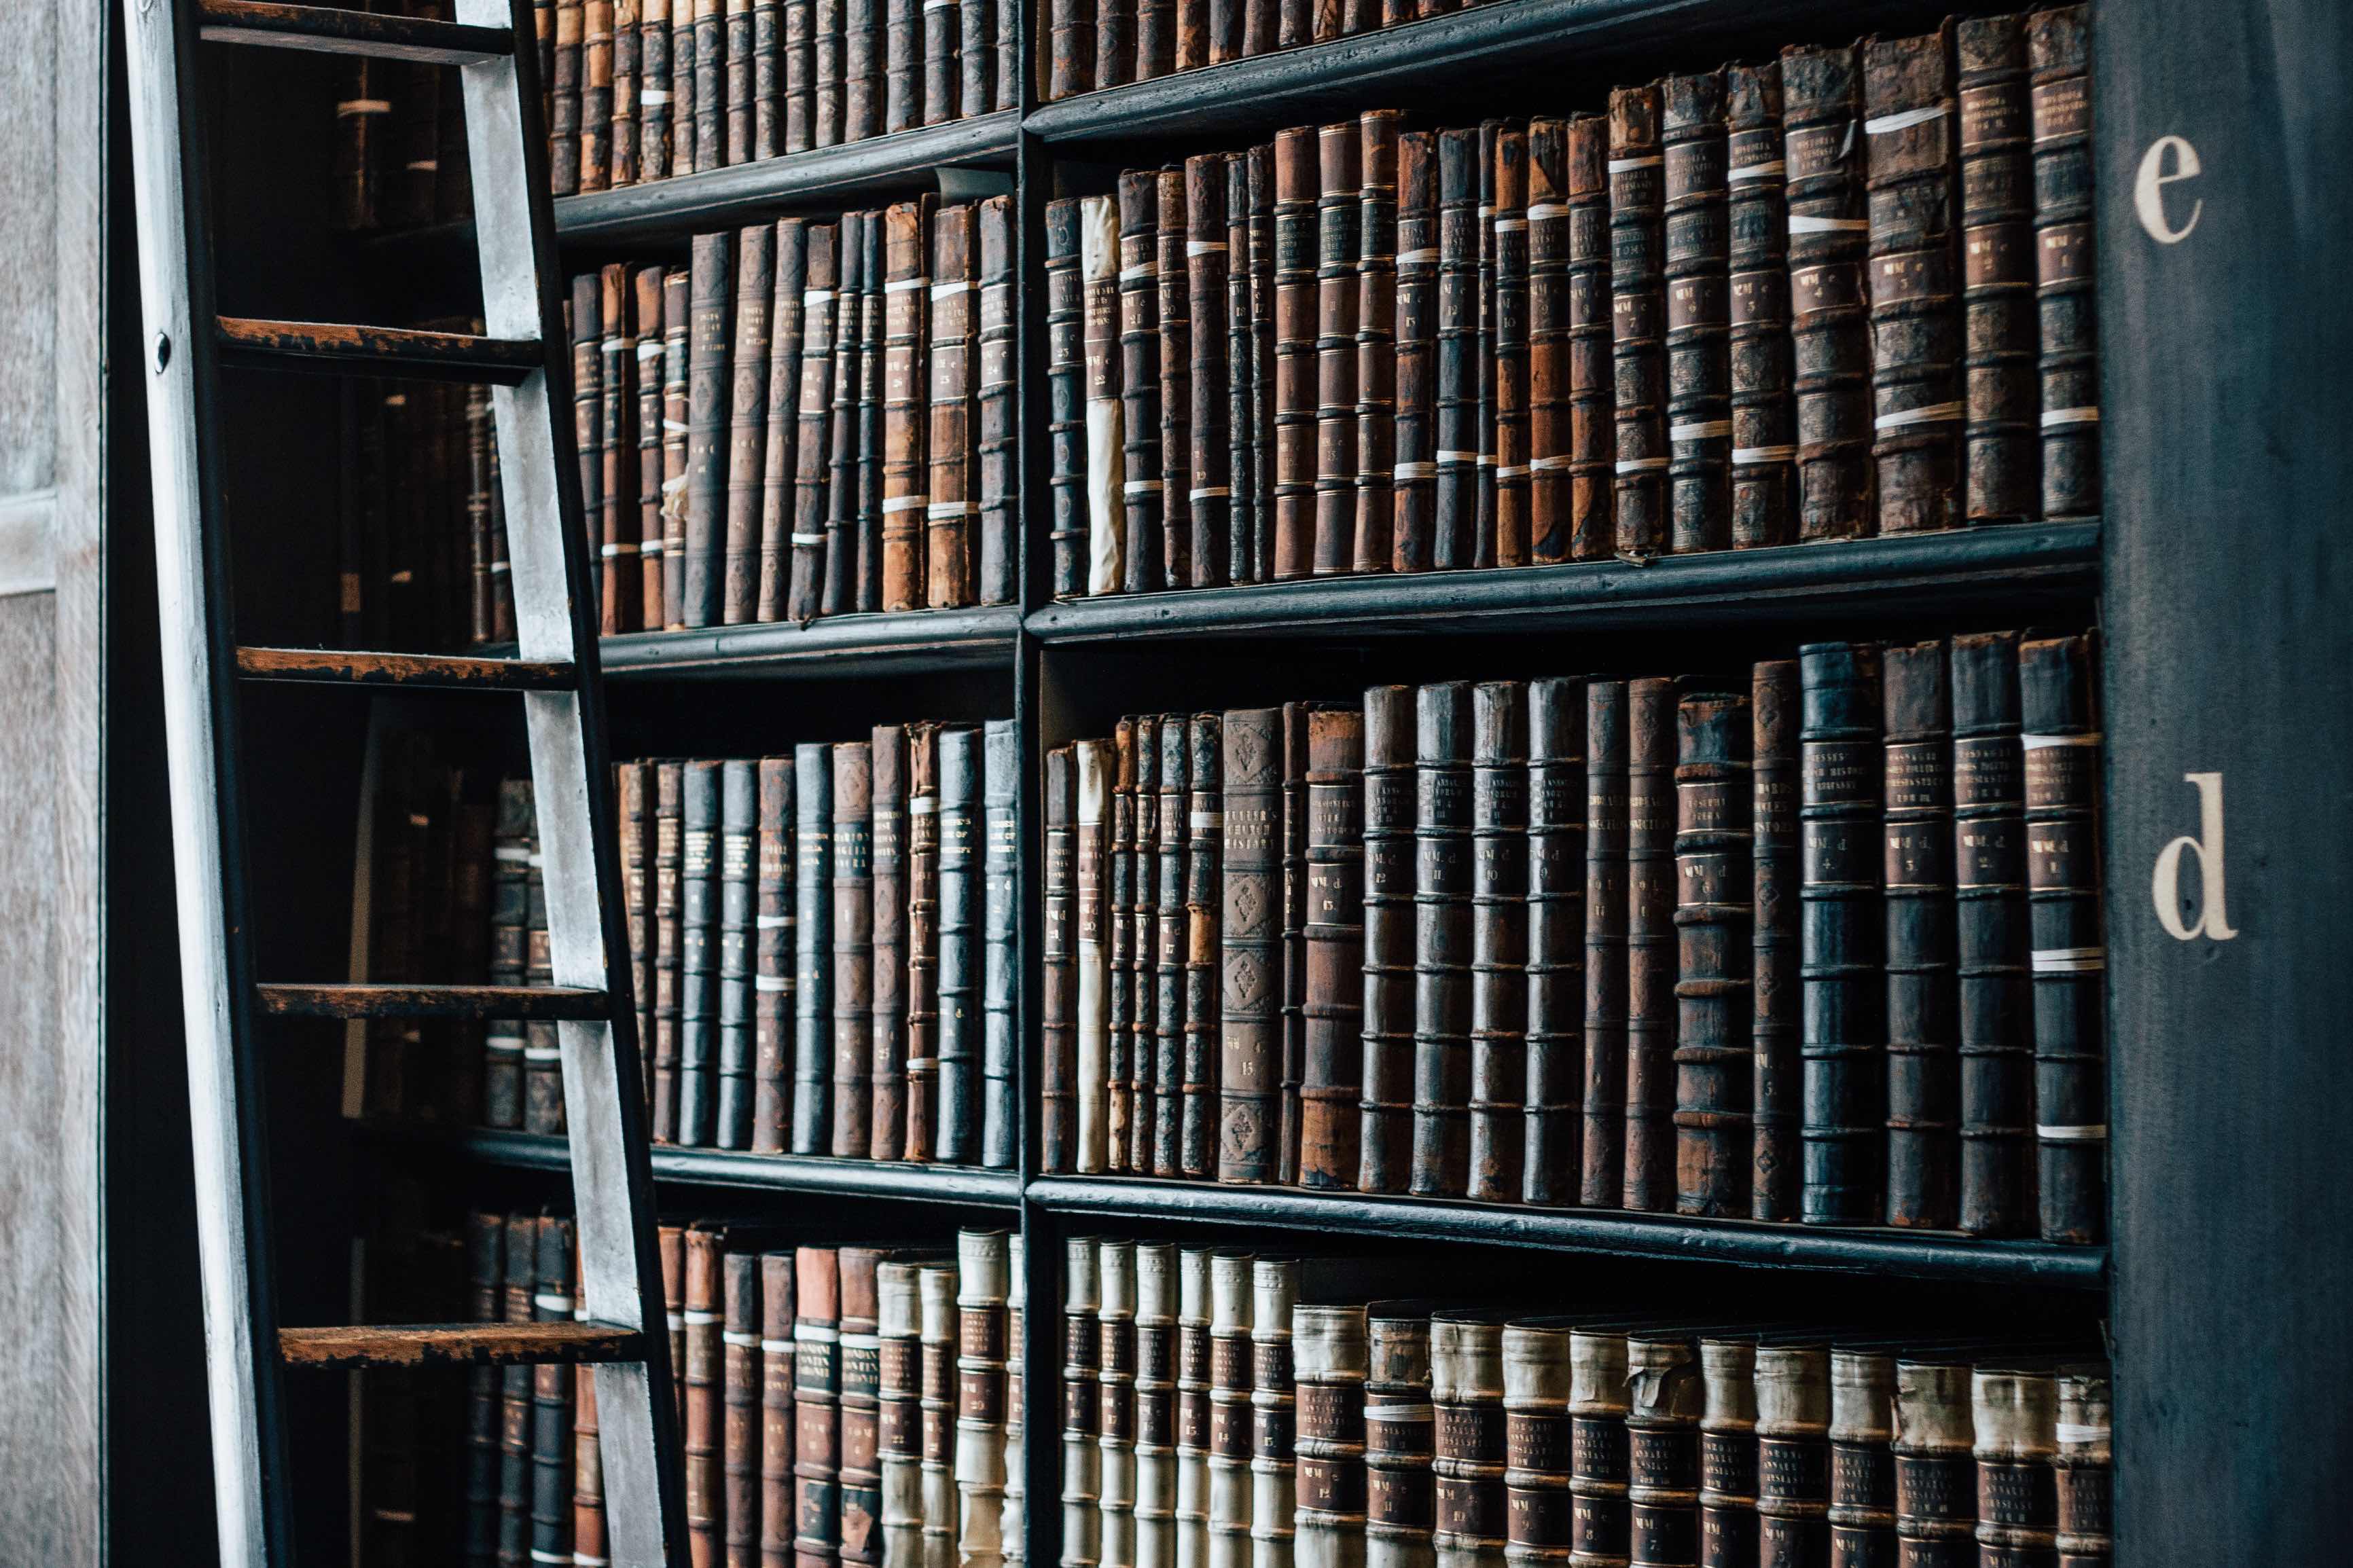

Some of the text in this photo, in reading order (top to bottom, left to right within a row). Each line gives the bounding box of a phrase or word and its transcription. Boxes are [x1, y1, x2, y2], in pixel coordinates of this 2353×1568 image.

[2135, 135, 2202, 244] e
[1503, 318, 1515, 328] 10
[1628, 318, 1637, 328] 7
[2153, 772, 2240, 941] d
